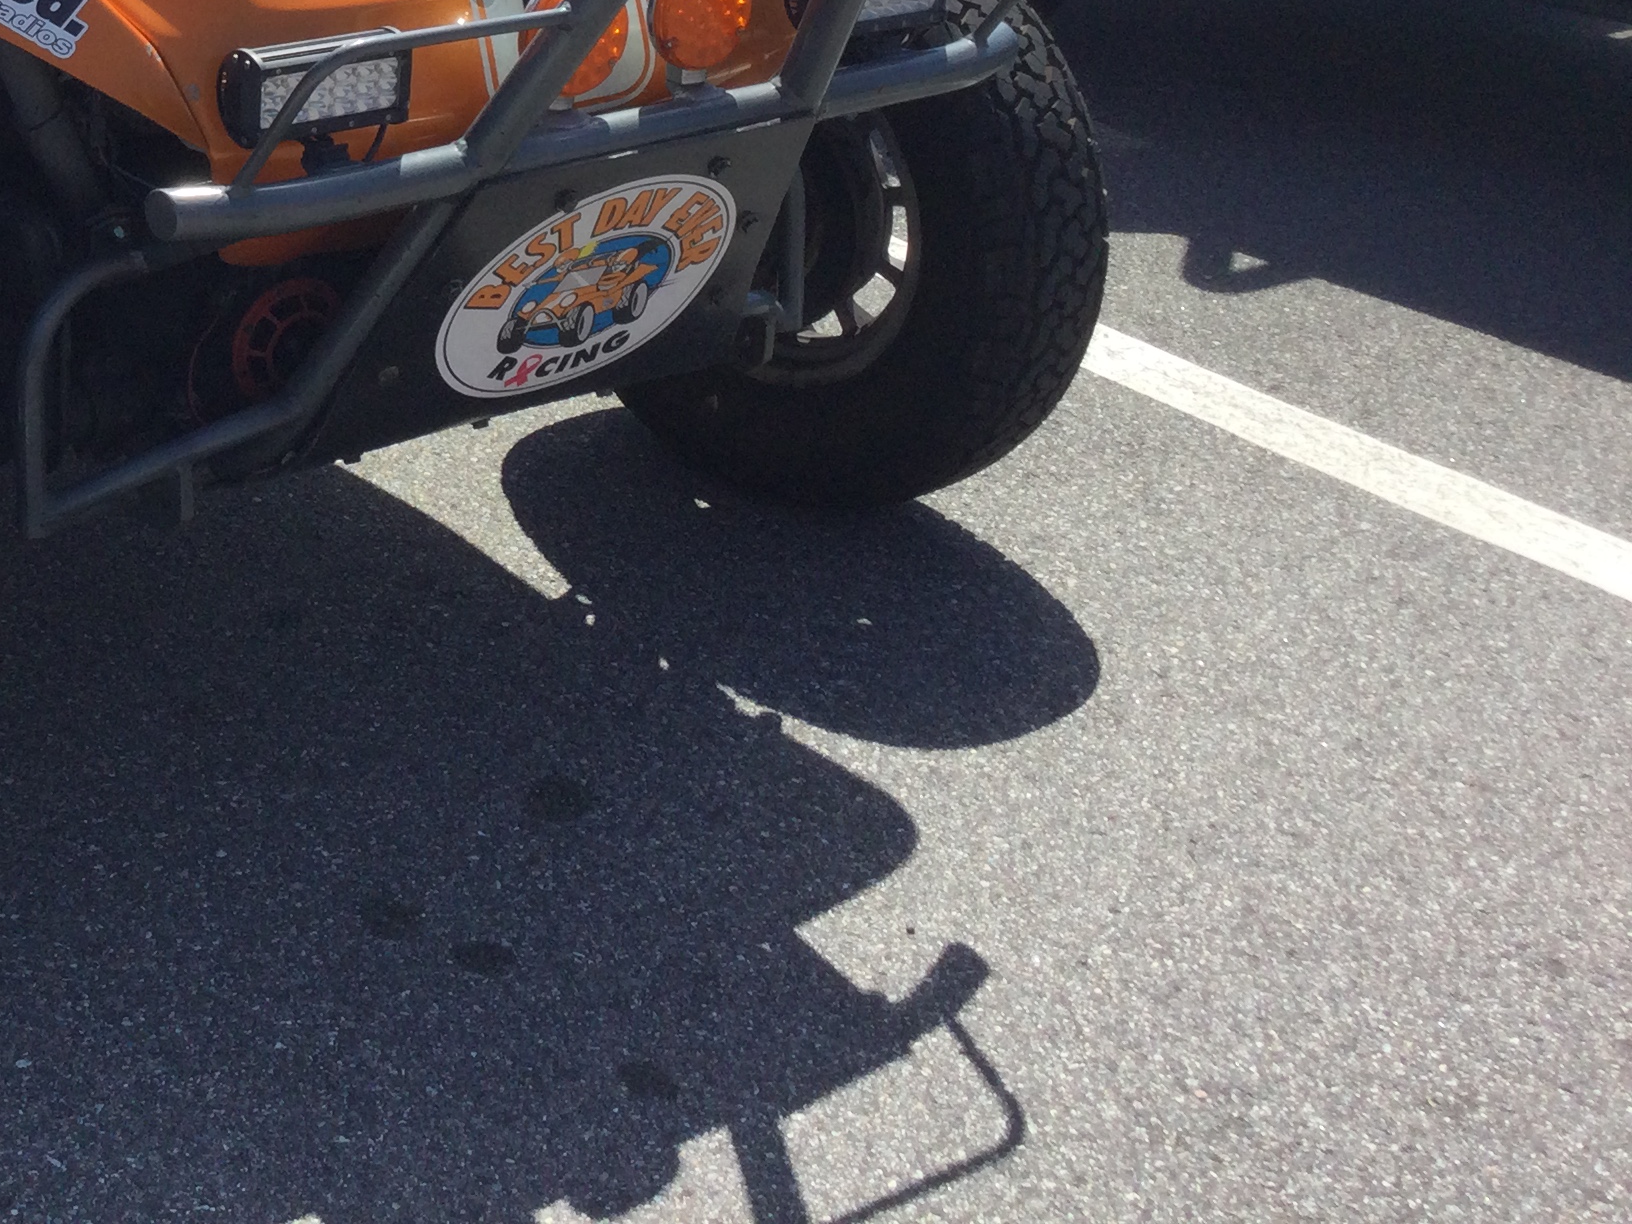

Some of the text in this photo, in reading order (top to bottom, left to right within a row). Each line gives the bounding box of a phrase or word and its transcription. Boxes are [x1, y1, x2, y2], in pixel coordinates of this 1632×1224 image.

[464, 187, 724, 310] BEST DAY EVER
